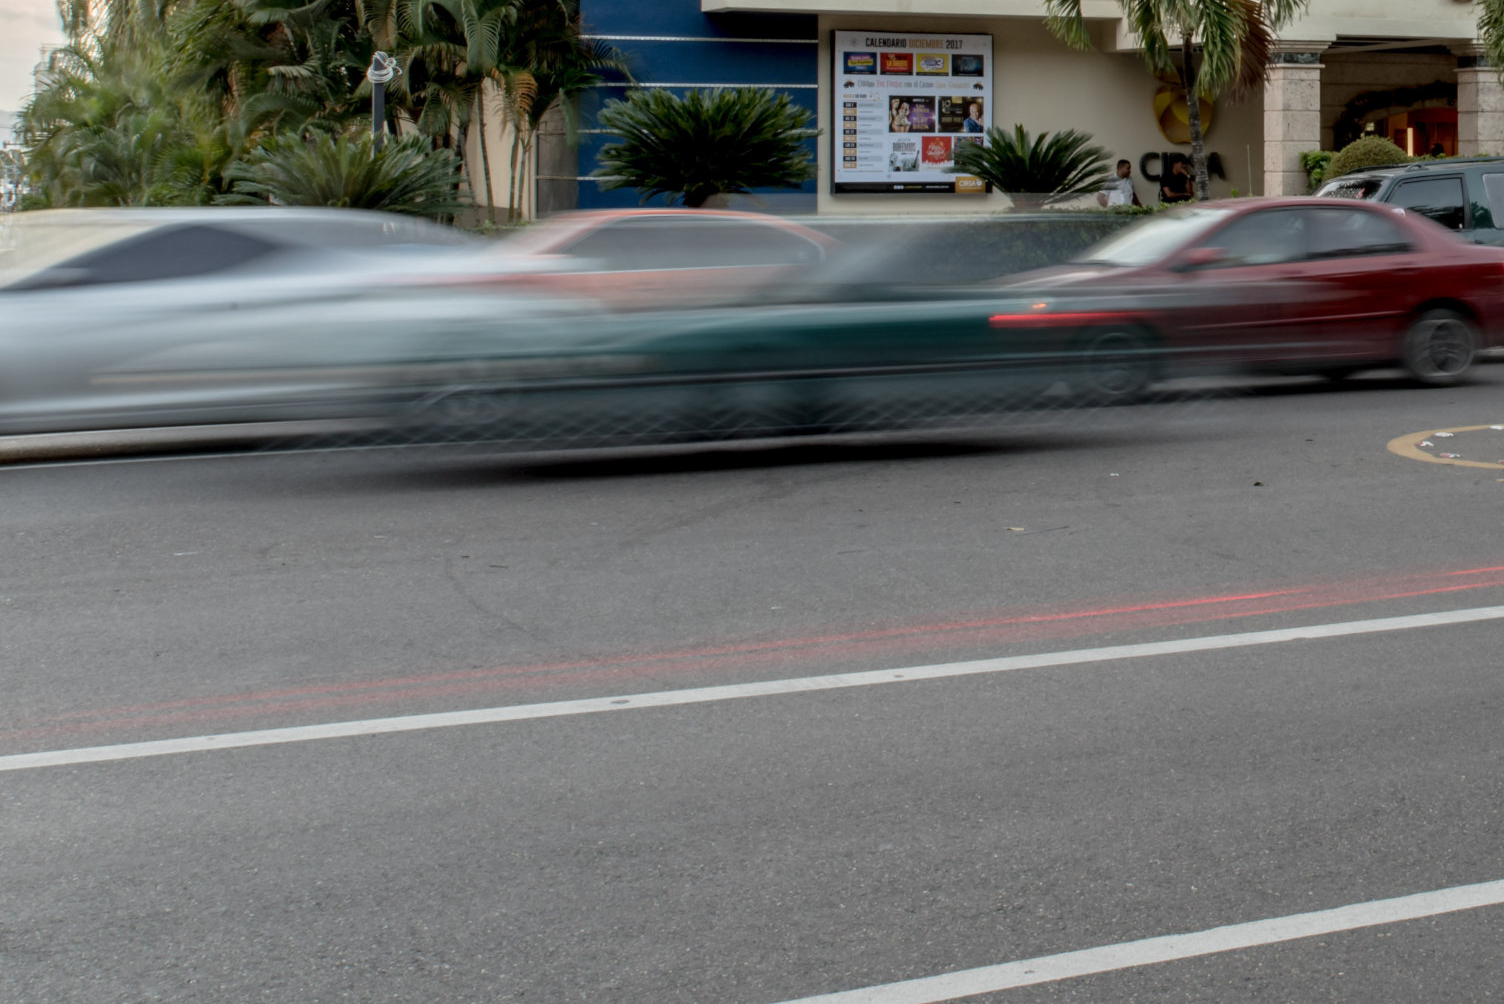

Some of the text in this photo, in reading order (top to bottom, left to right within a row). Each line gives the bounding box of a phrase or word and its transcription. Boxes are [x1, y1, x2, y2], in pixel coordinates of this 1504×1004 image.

[865, 37, 963, 50] CALENDARIO DICIEMBRE 2017
[1139, 152, 1226, 182] CIA
